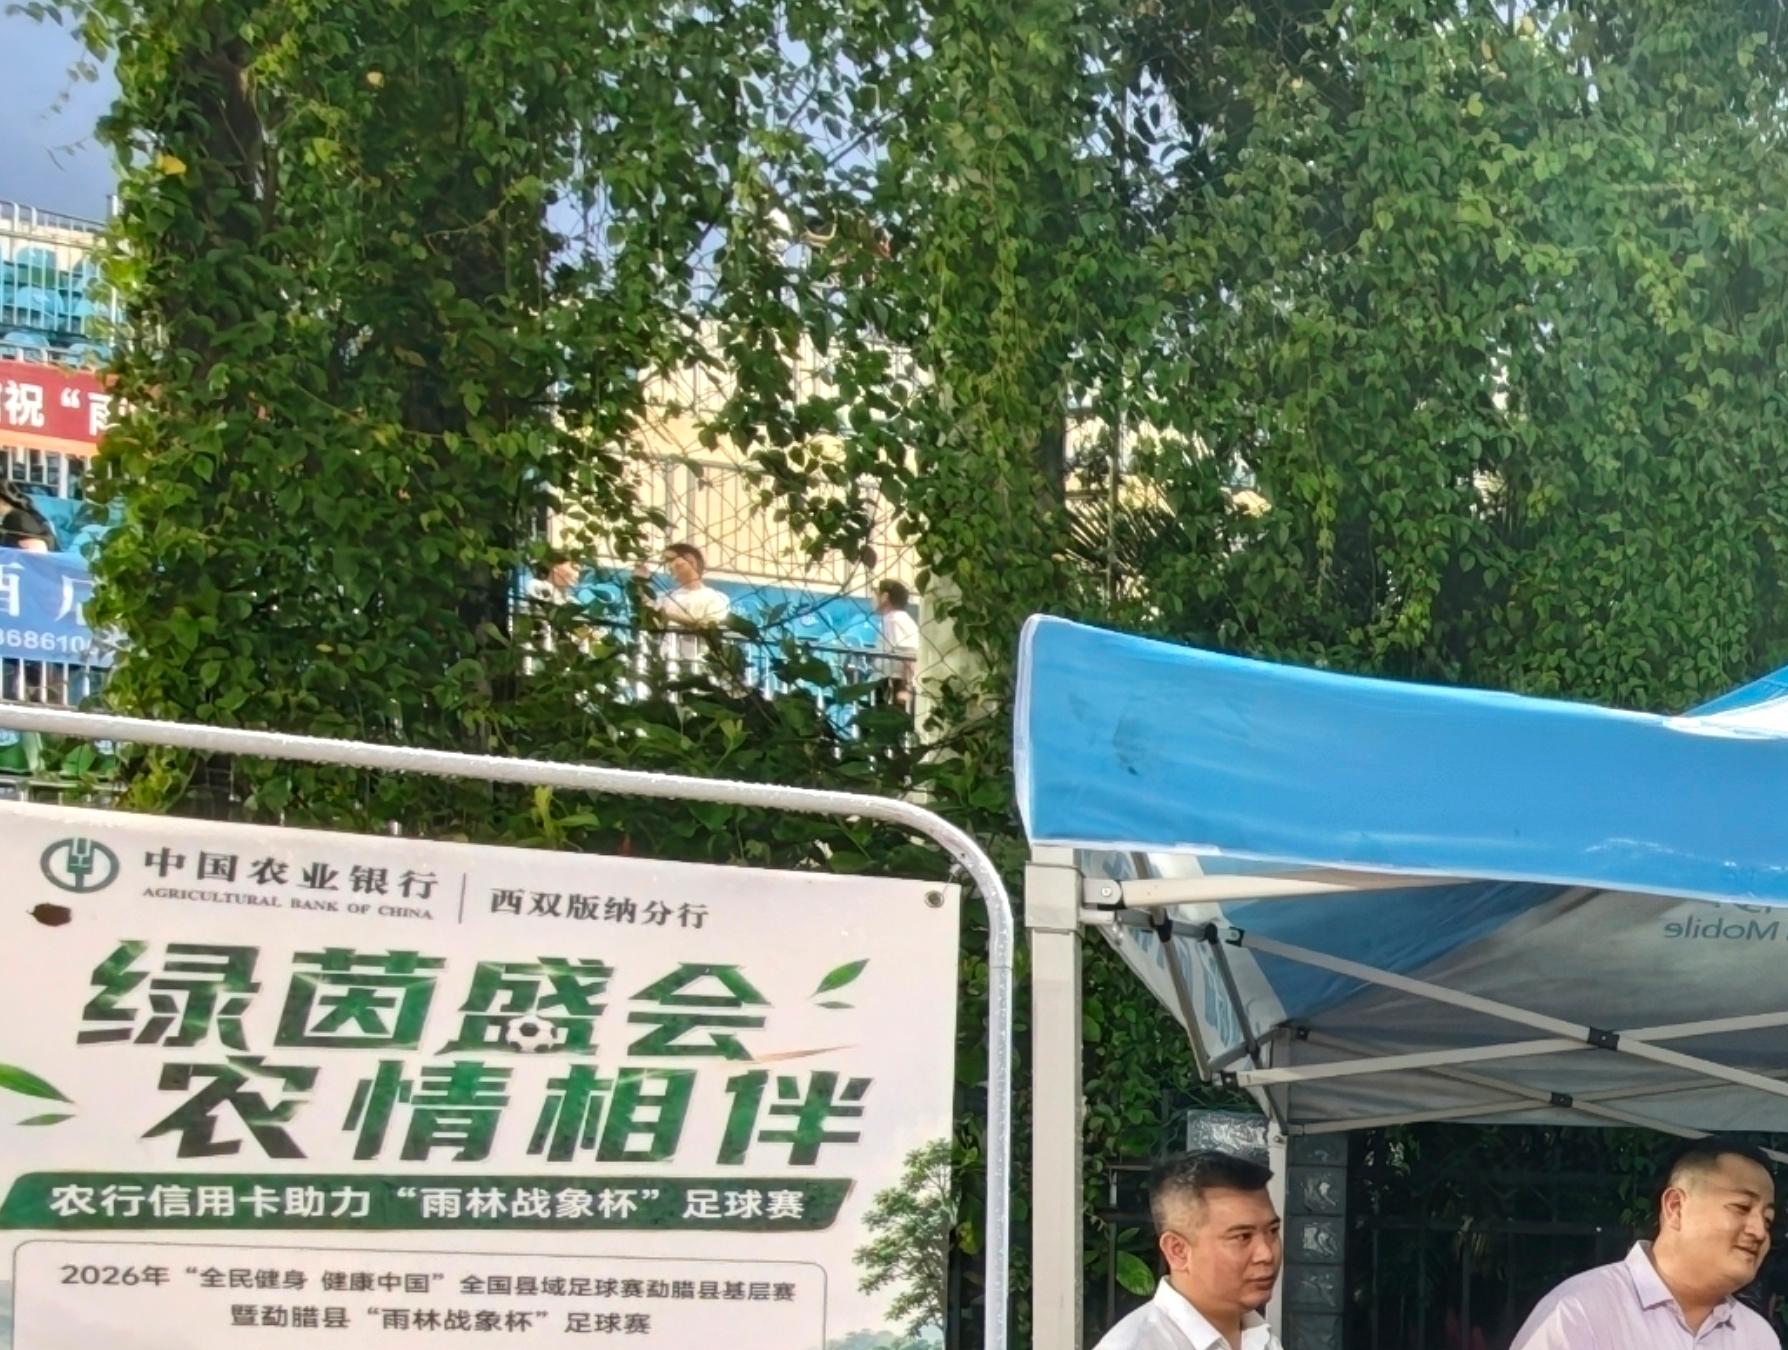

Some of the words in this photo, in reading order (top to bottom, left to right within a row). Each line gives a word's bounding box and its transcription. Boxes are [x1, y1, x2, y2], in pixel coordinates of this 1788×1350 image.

[143, 886, 282, 910] AGRICULTURAL
[290, 897, 339, 913] BANK
[347, 901, 370, 915] OF
[378, 904, 433, 921] CHINA
[144, 846, 440, 901] 中国农业银行
[490, 888, 710, 929] 西双版纳分行
[76, 939, 772, 1061] 绿茵盛会
[142, 1055, 874, 1167] 农情相伴
